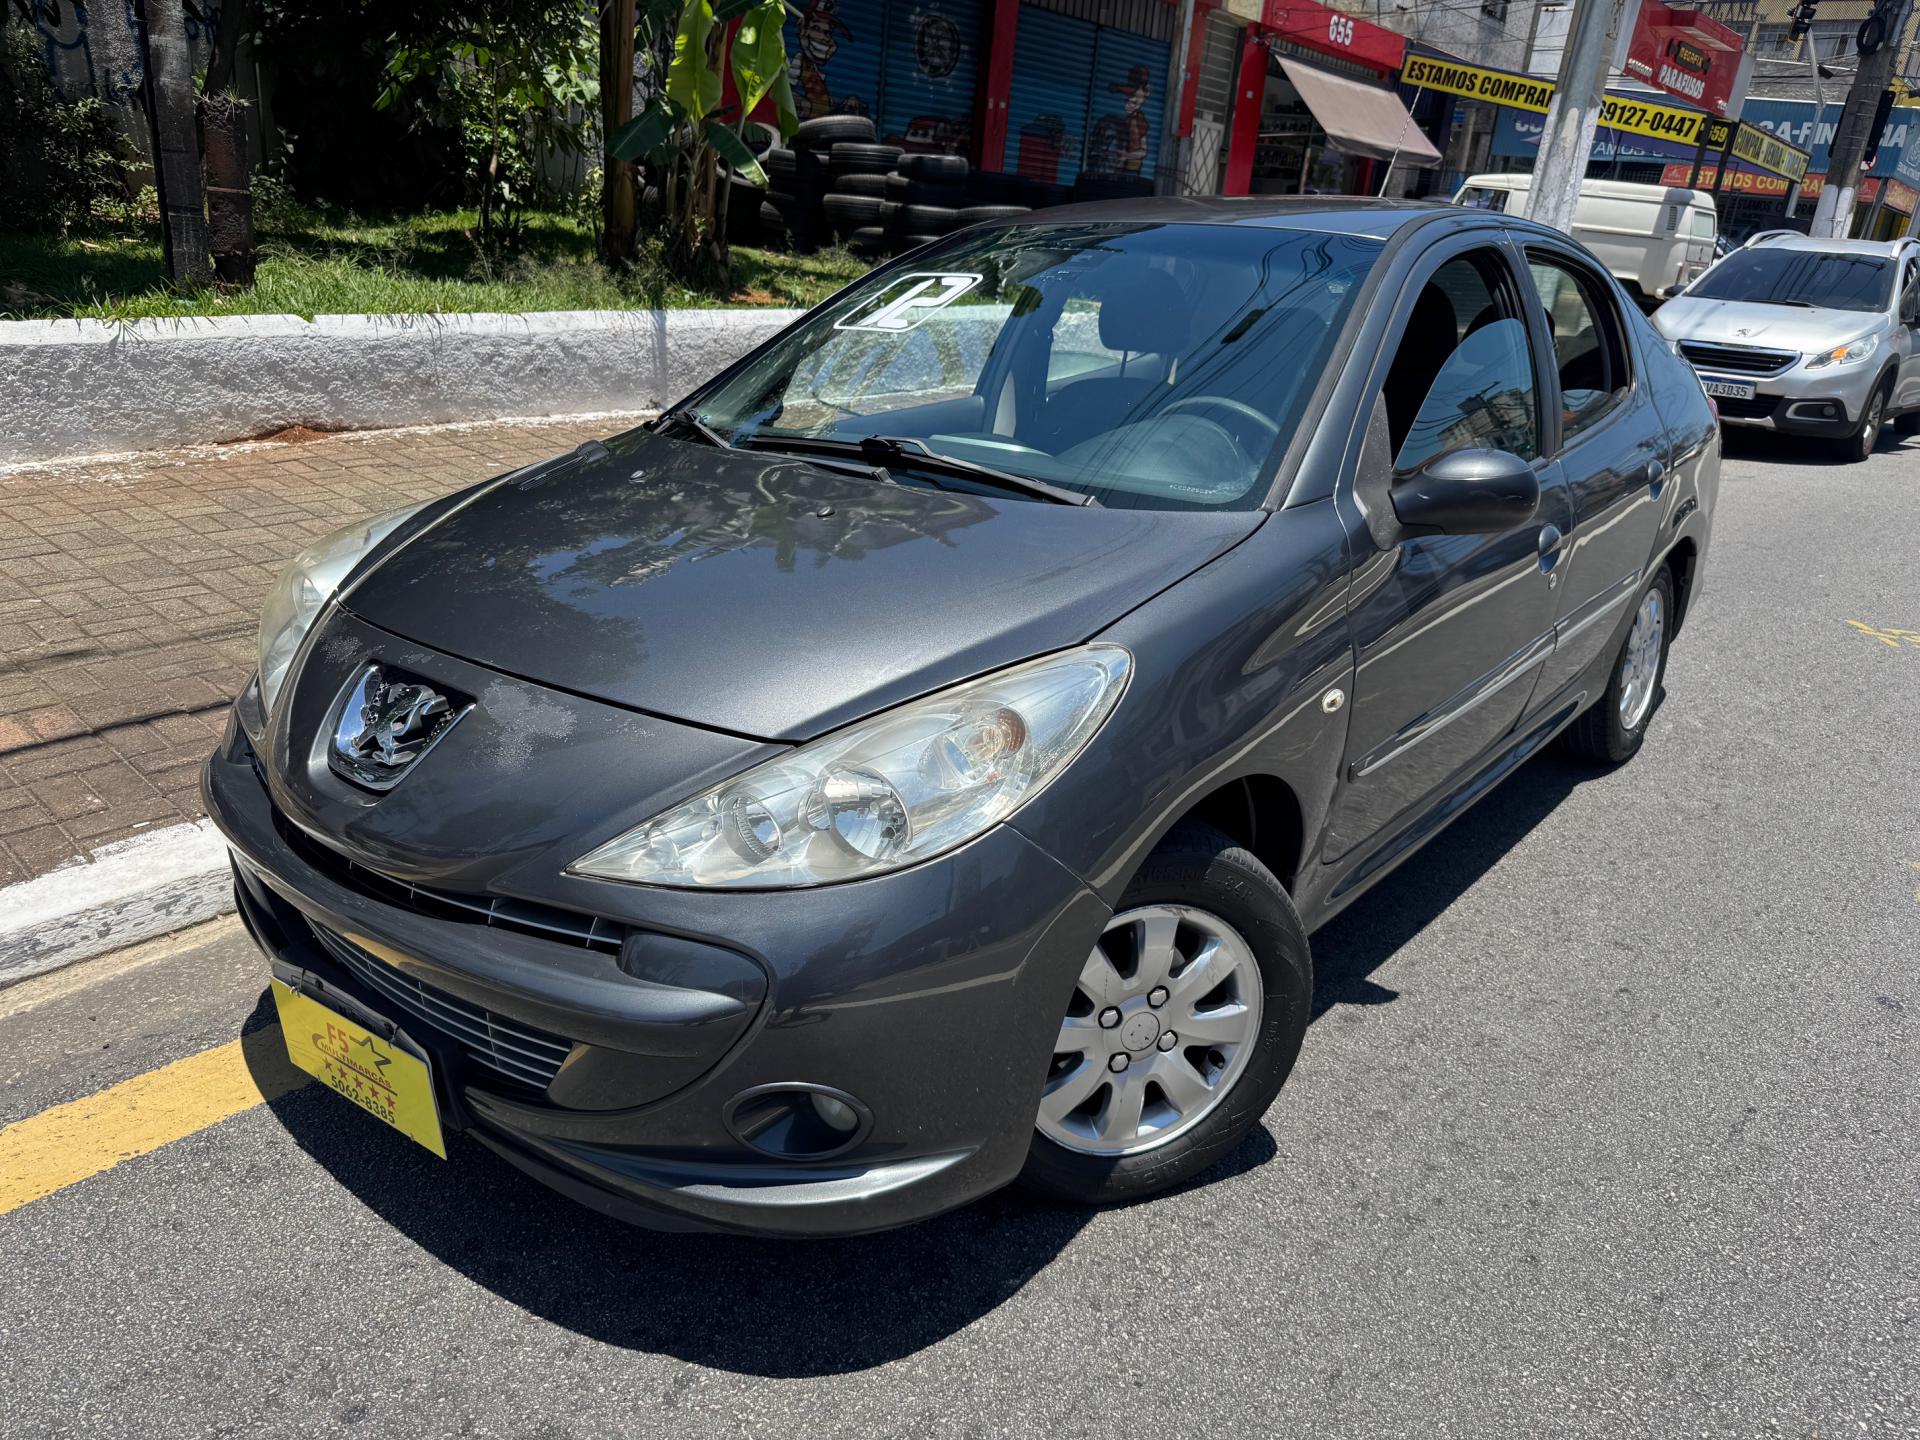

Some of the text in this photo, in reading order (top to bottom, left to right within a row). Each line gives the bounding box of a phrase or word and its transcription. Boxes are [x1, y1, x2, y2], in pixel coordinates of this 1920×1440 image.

[1329, 15, 1354, 46] 655
[1407, 61, 1478, 94] ESTAMOS
[1658, 64, 1706, 100] PARAFUSOS
[1733, 126, 1764, 161] COMPRA
[860, 276, 973, 329] 12
[325, 1022, 350, 1054] F5
[320, 1041, 393, 1090] MULTIMARCAS
[331, 1074, 397, 1125] 5062-8385
